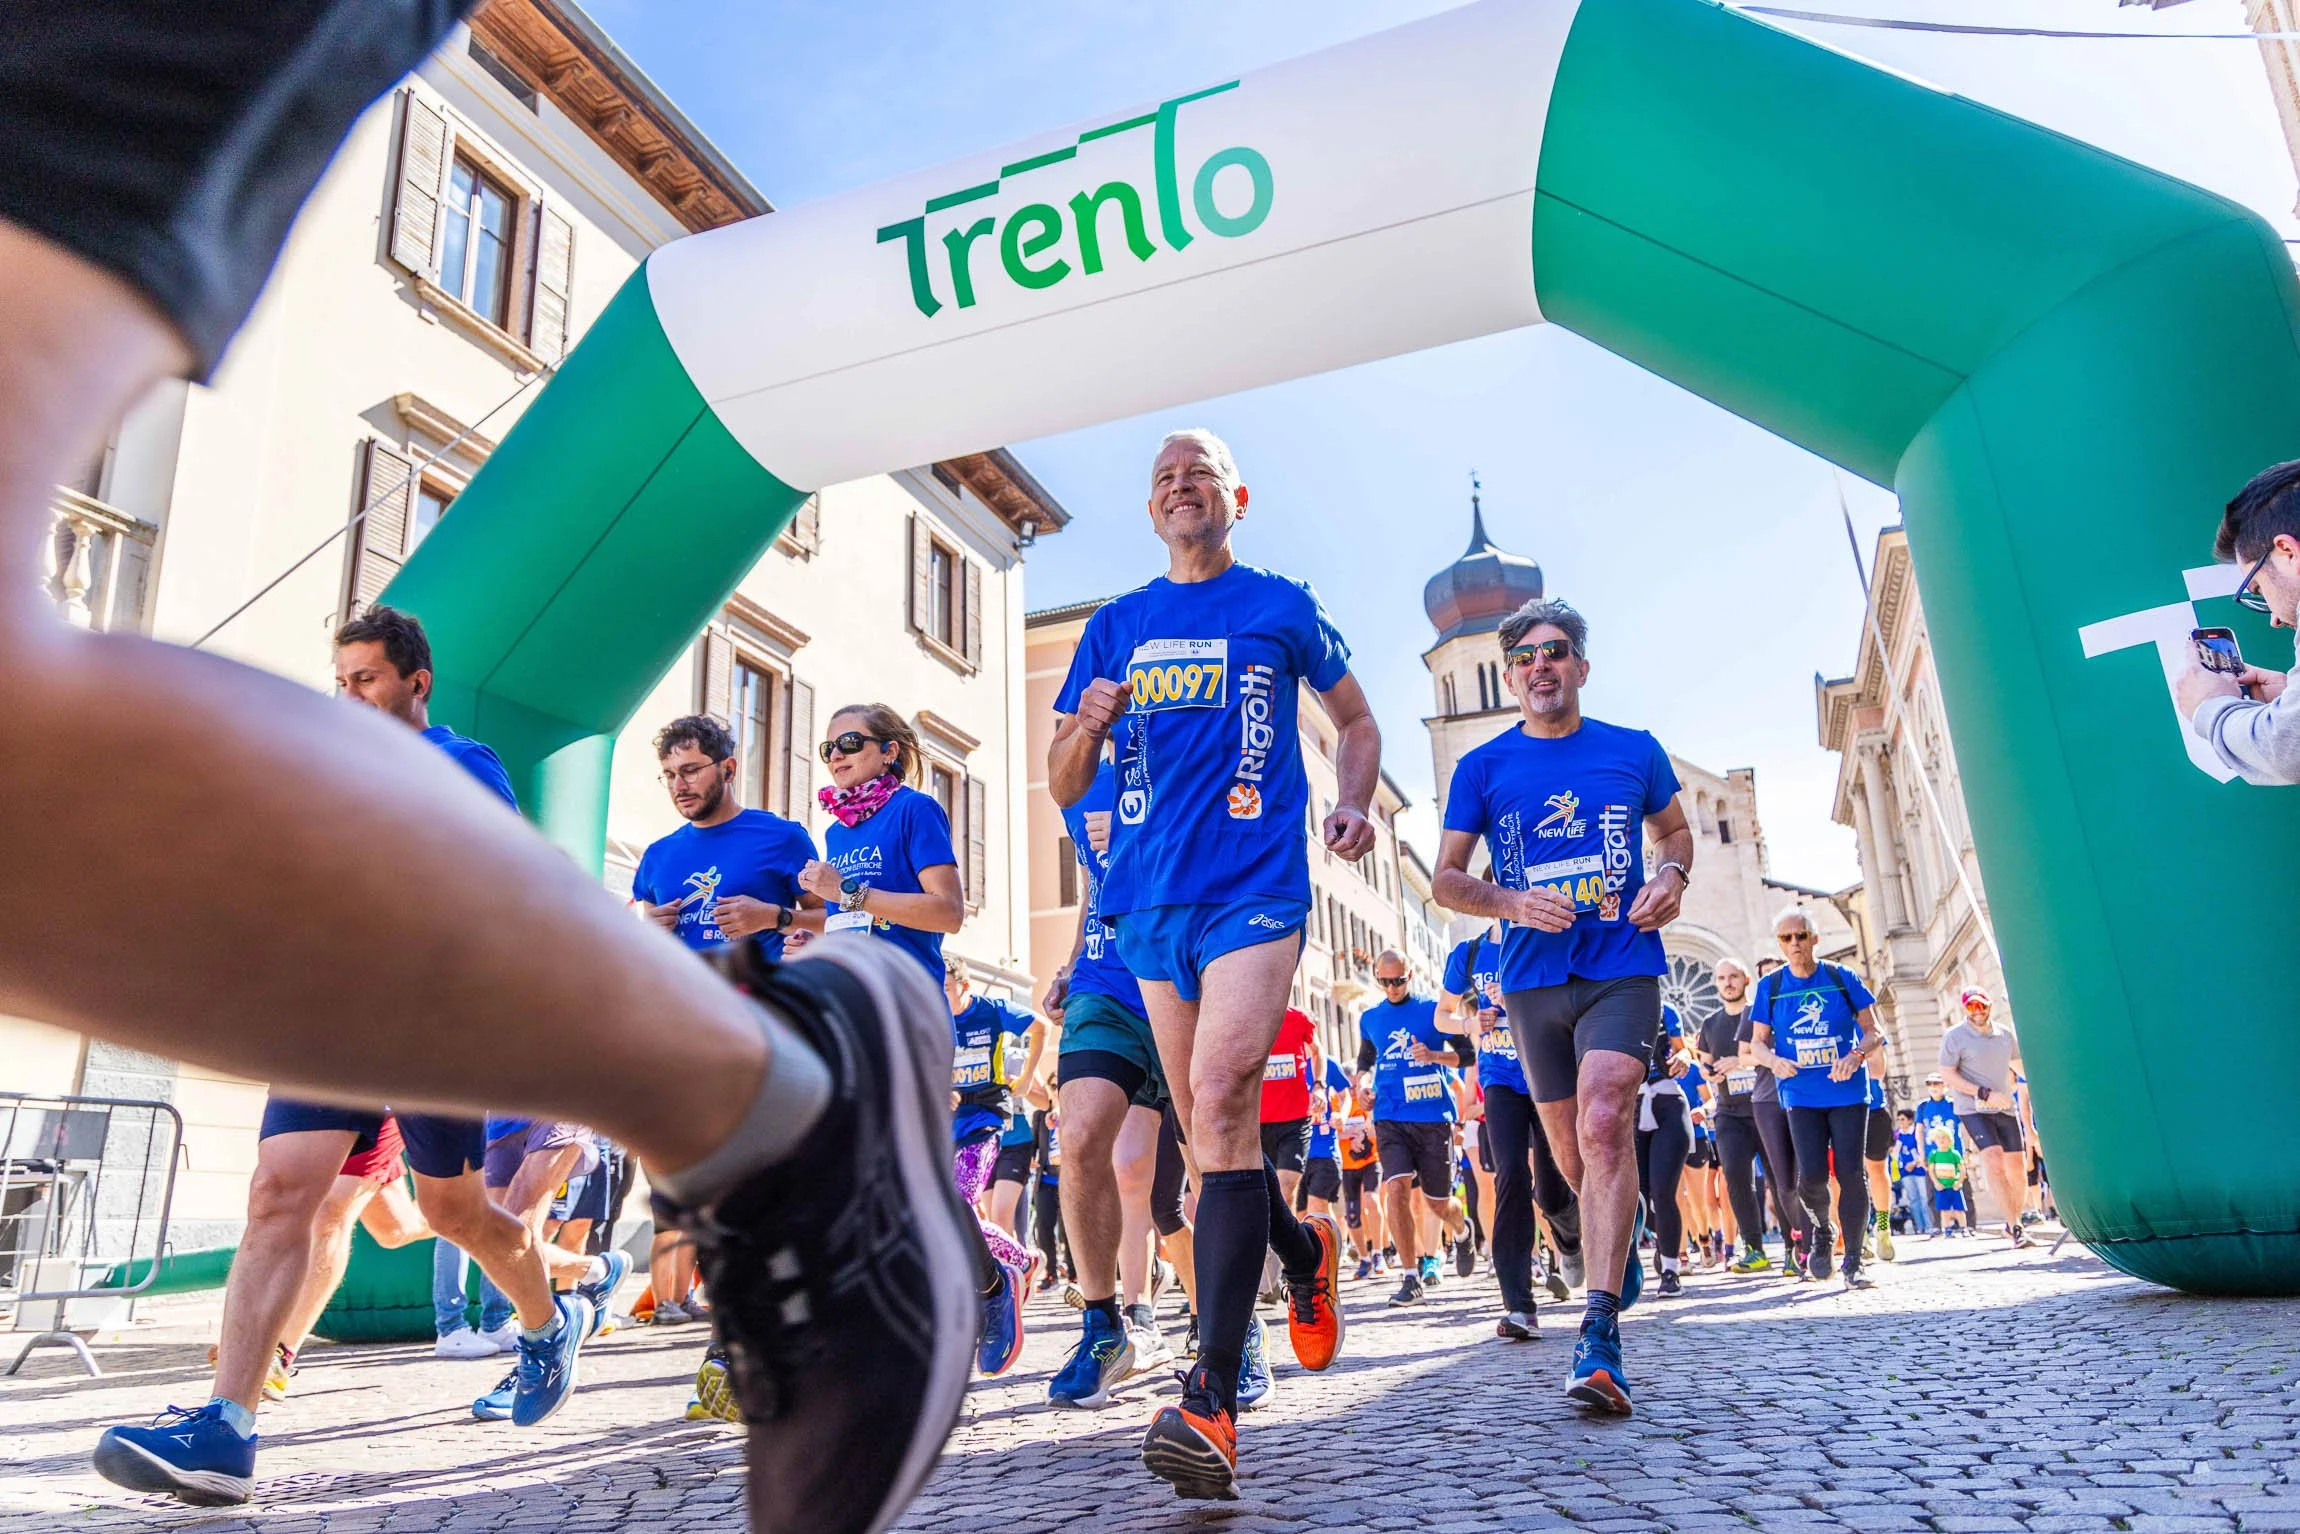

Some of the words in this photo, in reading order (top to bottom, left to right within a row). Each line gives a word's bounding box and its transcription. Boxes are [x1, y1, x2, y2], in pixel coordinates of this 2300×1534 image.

[877, 80, 1274, 318] Trento
[1163, 640, 1186, 649] LIFE
[1189, 640, 1212, 648] RUN
[1131, 664, 1223, 705] 00097
[1234, 665, 1275, 781] Rigotti
[1498, 815, 1515, 889] IACCA
[1538, 827, 1566, 838] NEW
[1598, 805, 1632, 893] Rigotti
[1532, 863, 1551, 872] NEW
[1553, 861, 1571, 869] LIFE
[1573, 857, 1591, 865] RUN
[1548, 876, 1603, 905] 140
